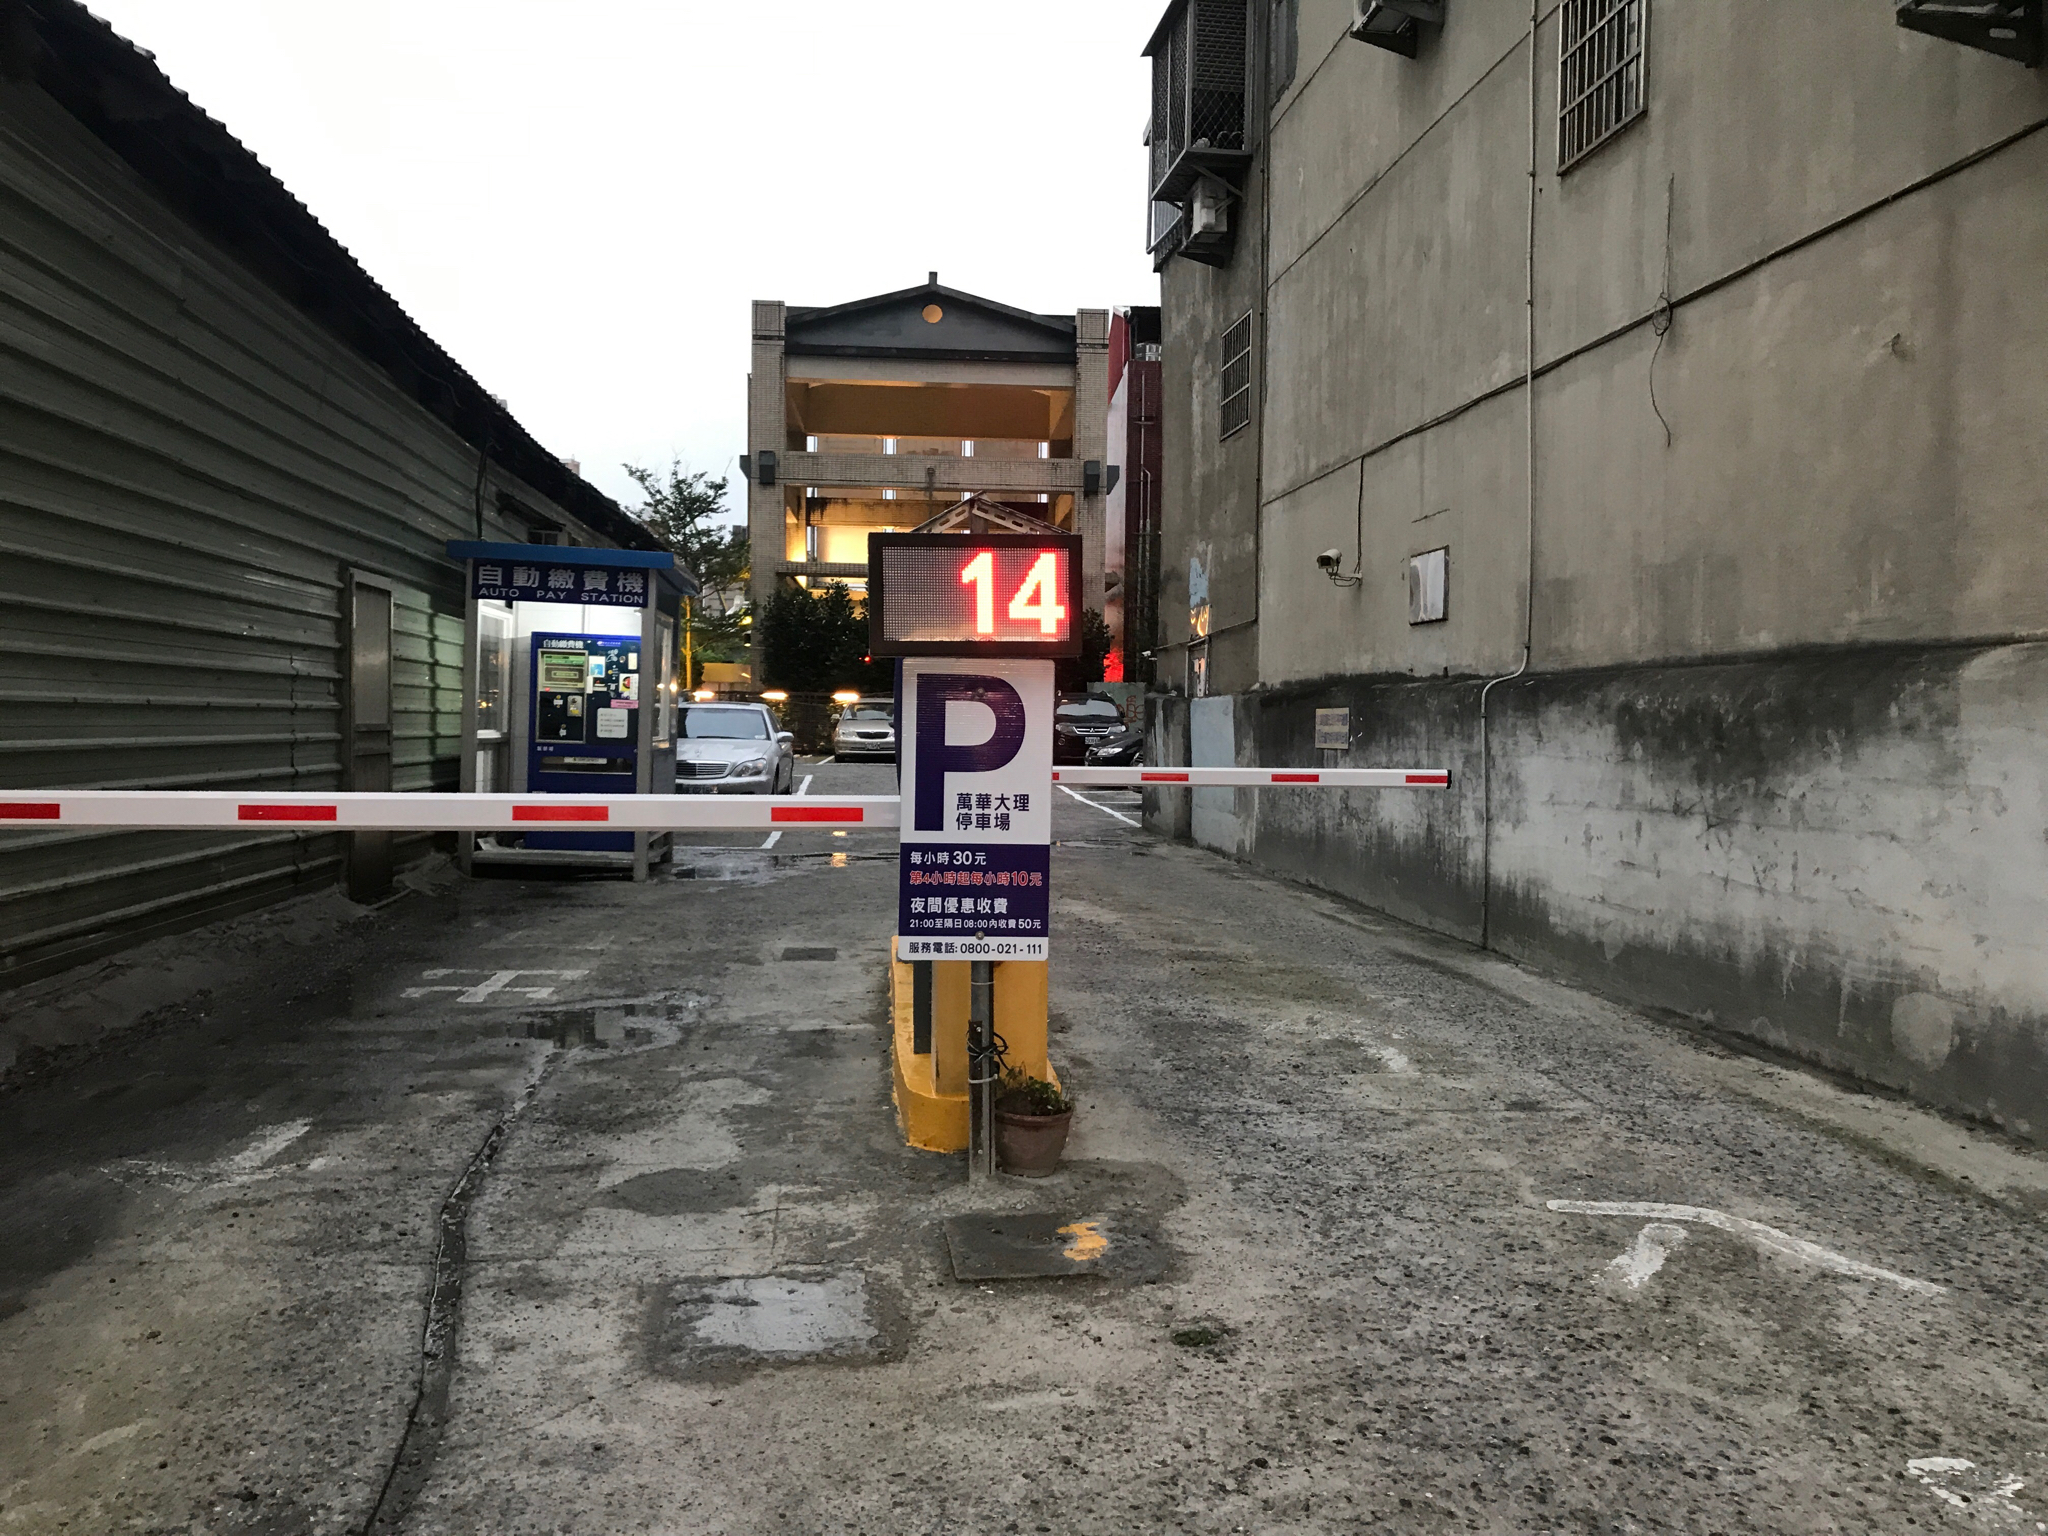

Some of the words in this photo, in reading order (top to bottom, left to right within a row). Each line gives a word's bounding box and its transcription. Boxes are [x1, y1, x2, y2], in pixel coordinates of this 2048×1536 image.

[478, 565, 644, 594] 自動繳費機
[478, 587, 520, 598] AUTO
[536, 590, 568, 600] PAY
[581, 593, 644, 604] STATION
[961, 551, 1066, 635] 14
[914, 673, 1026, 831] P
[956, 792, 1030, 812] 萬華大理
[955, 812, 1011, 831] 停車場
[909, 870, 1043, 886] 第4小時起每小時10元
[910, 897, 1008, 914] 夜間優惠收費
